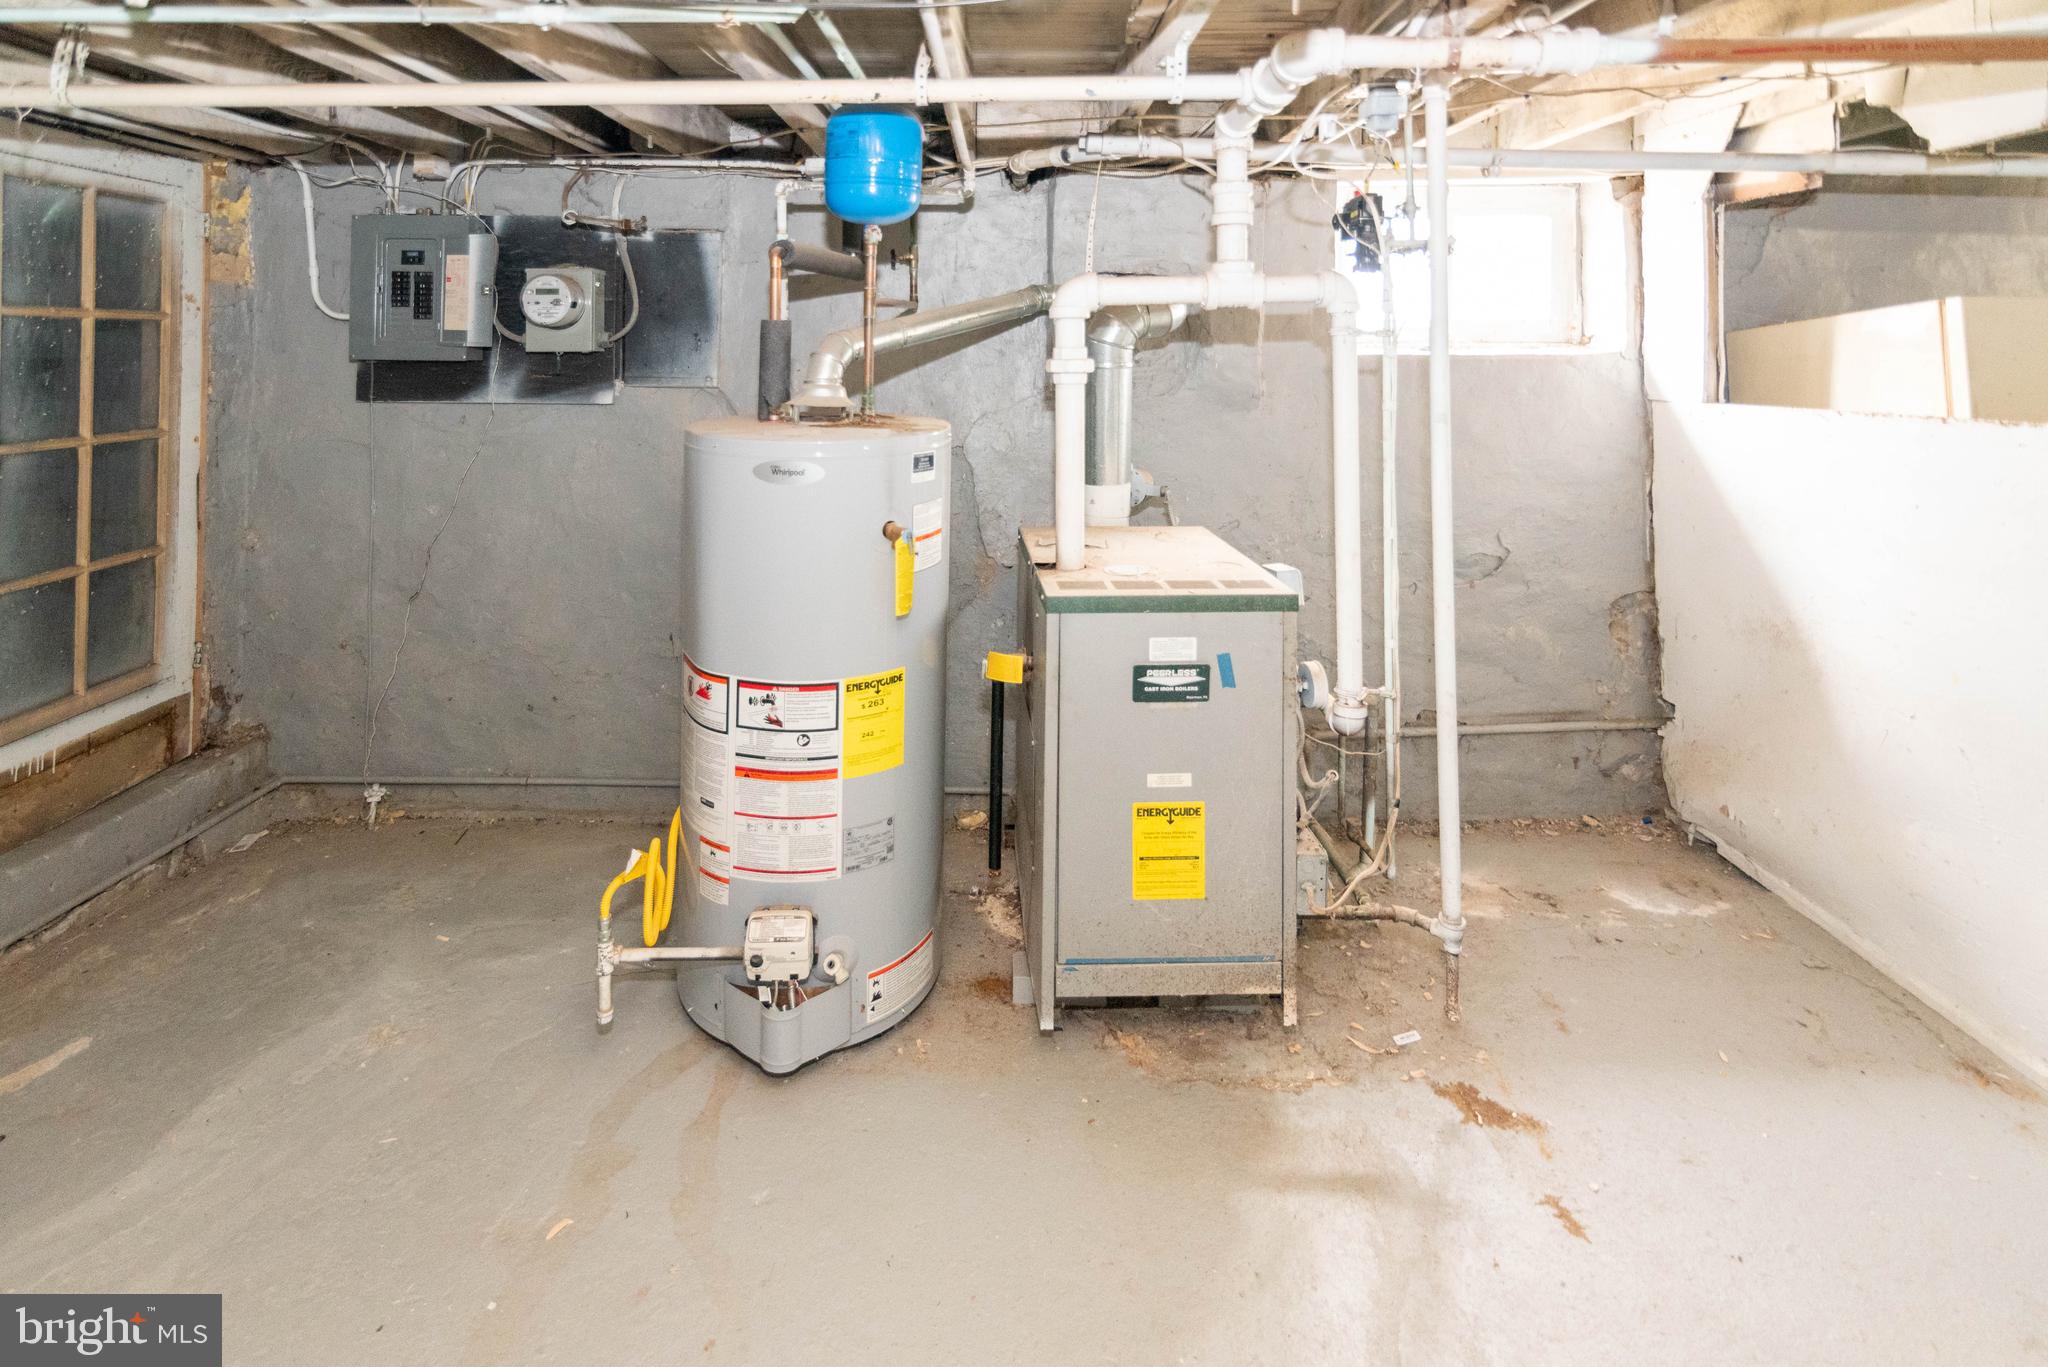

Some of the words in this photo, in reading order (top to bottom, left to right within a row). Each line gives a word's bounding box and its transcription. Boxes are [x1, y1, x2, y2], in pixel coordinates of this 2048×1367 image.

[771, 468, 805, 477] Whirlpool
[1146, 669, 1197, 677] PEERLESS
[846, 673, 904, 693] ENERGYGUIDE
[1136, 807, 1201, 818] ENERGYGUIDE
